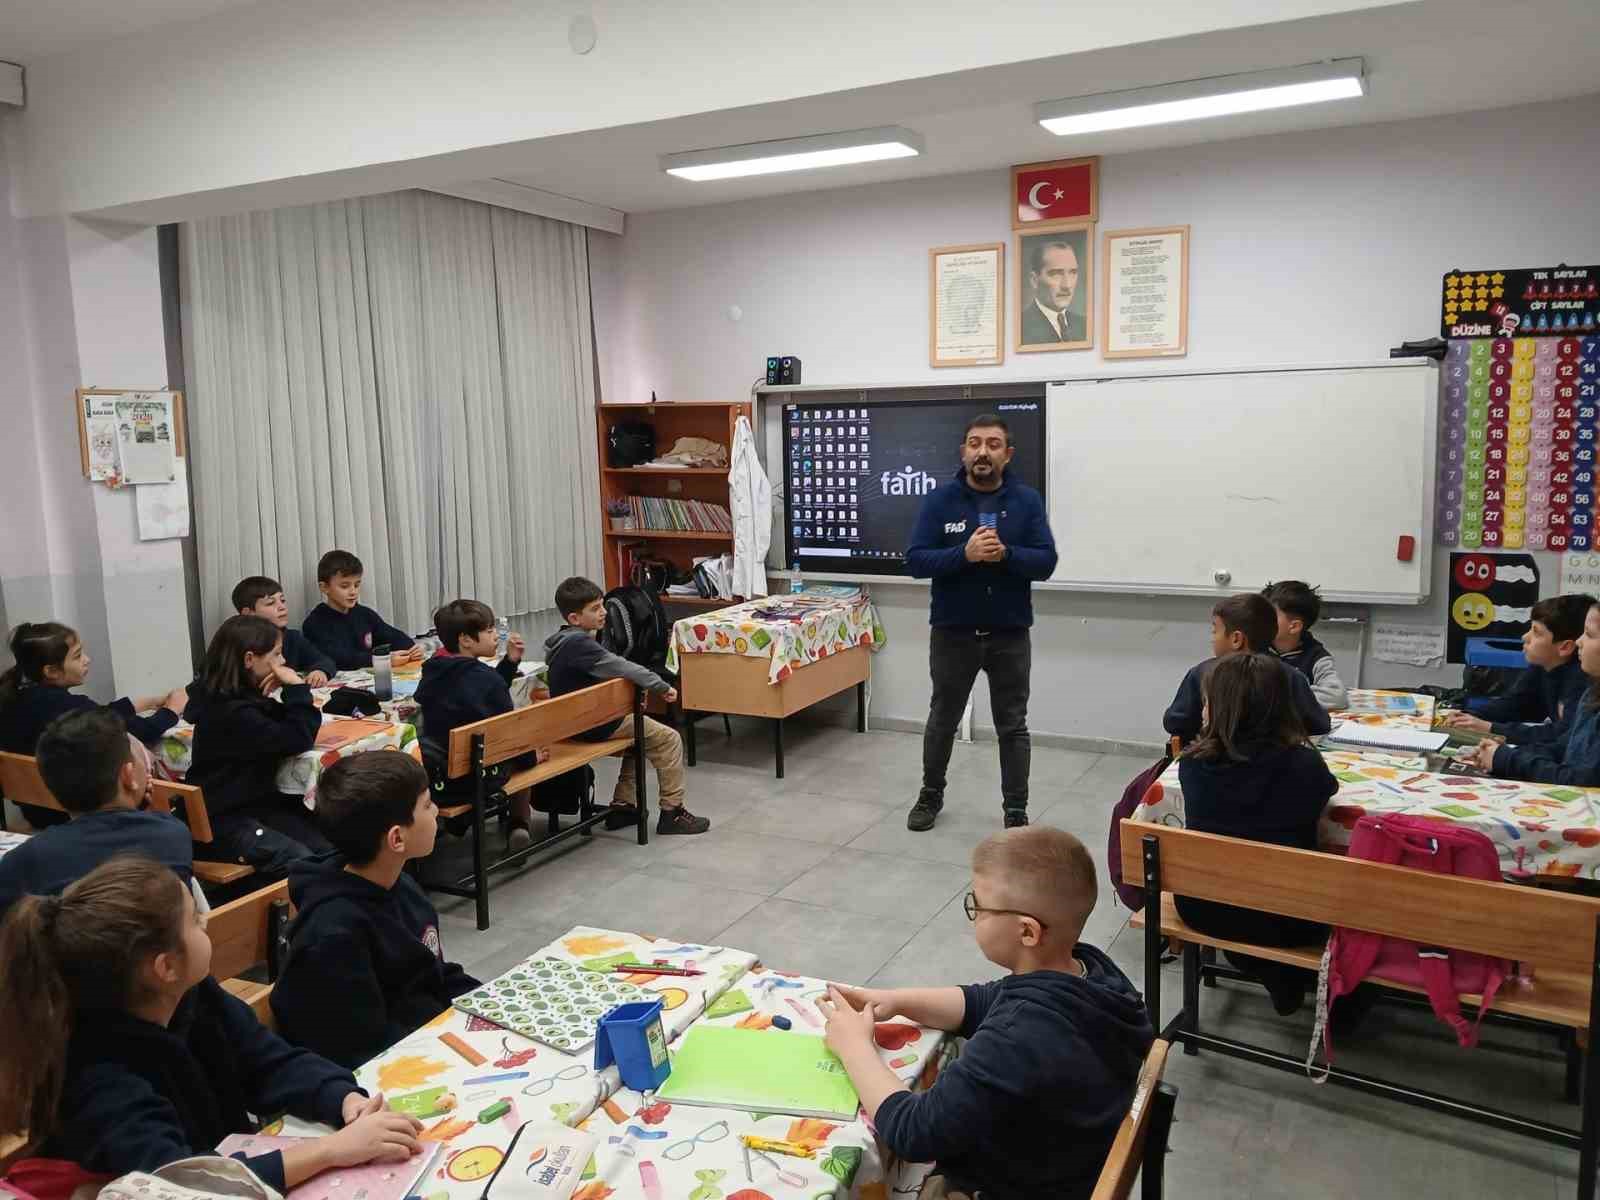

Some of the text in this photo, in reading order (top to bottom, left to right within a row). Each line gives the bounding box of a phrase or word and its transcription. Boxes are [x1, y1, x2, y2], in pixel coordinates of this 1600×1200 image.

[1456, 345, 1462, 354] 1
[1477, 345, 1483, 355] 2
[1497, 344, 1506, 353] 3
[1563, 344, 1571, 353] 6
[1587, 343, 1596, 353] 7
[1454, 367, 1462, 377] 2
[1475, 367, 1482, 376] 4
[1496, 365, 1504, 375] 6
[1560, 366, 1573, 376] 12
[1583, 364, 1596, 373] 14
[1474, 388, 1481, 397] 6
[1495, 387, 1503, 396] 9
[1559, 387, 1573, 397] 18
[1581, 386, 1595, 395] 21
[1472, 409, 1480, 418] 8
[1492, 408, 1504, 418] 12
[1537, 409, 1549, 418] 20
[1557, 408, 1571, 418] 24
[1580, 407, 1594, 417] 28
[1471, 430, 1481, 439] 10
[1491, 429, 1504, 439] 15
[1556, 430, 1570, 440] 30
[1578, 429, 1593, 439] 35
[1469, 450, 1481, 459] 12
[1489, 450, 1502, 459] 18
[1555, 451, 1569, 462] 36
[1576, 450, 1592, 460] 42
[1449, 471, 1455, 480] 7
[1468, 471, 1479, 480] 14
[1488, 470, 1500, 479] 21
[1553, 473, 1568, 482] 42
[1575, 472, 1590, 482] 49
[1467, 491, 1478, 500] 16
[1486, 490, 1500, 500] 24
[1553, 493, 1567, 503] 48
[1575, 494, 1589, 504] 56
[1466, 512, 1477, 521] 18
[1485, 511, 1499, 521] 27
[1551, 514, 1565, 524] 54
[1573, 514, 1588, 525] 63
[1464, 531, 1477, 541] 20
[1483, 531, 1497, 541] 30
[1529, 534, 1543, 544] 50
[1551, 535, 1565, 545] 60
[1572, 536, 1586, 545] 70
